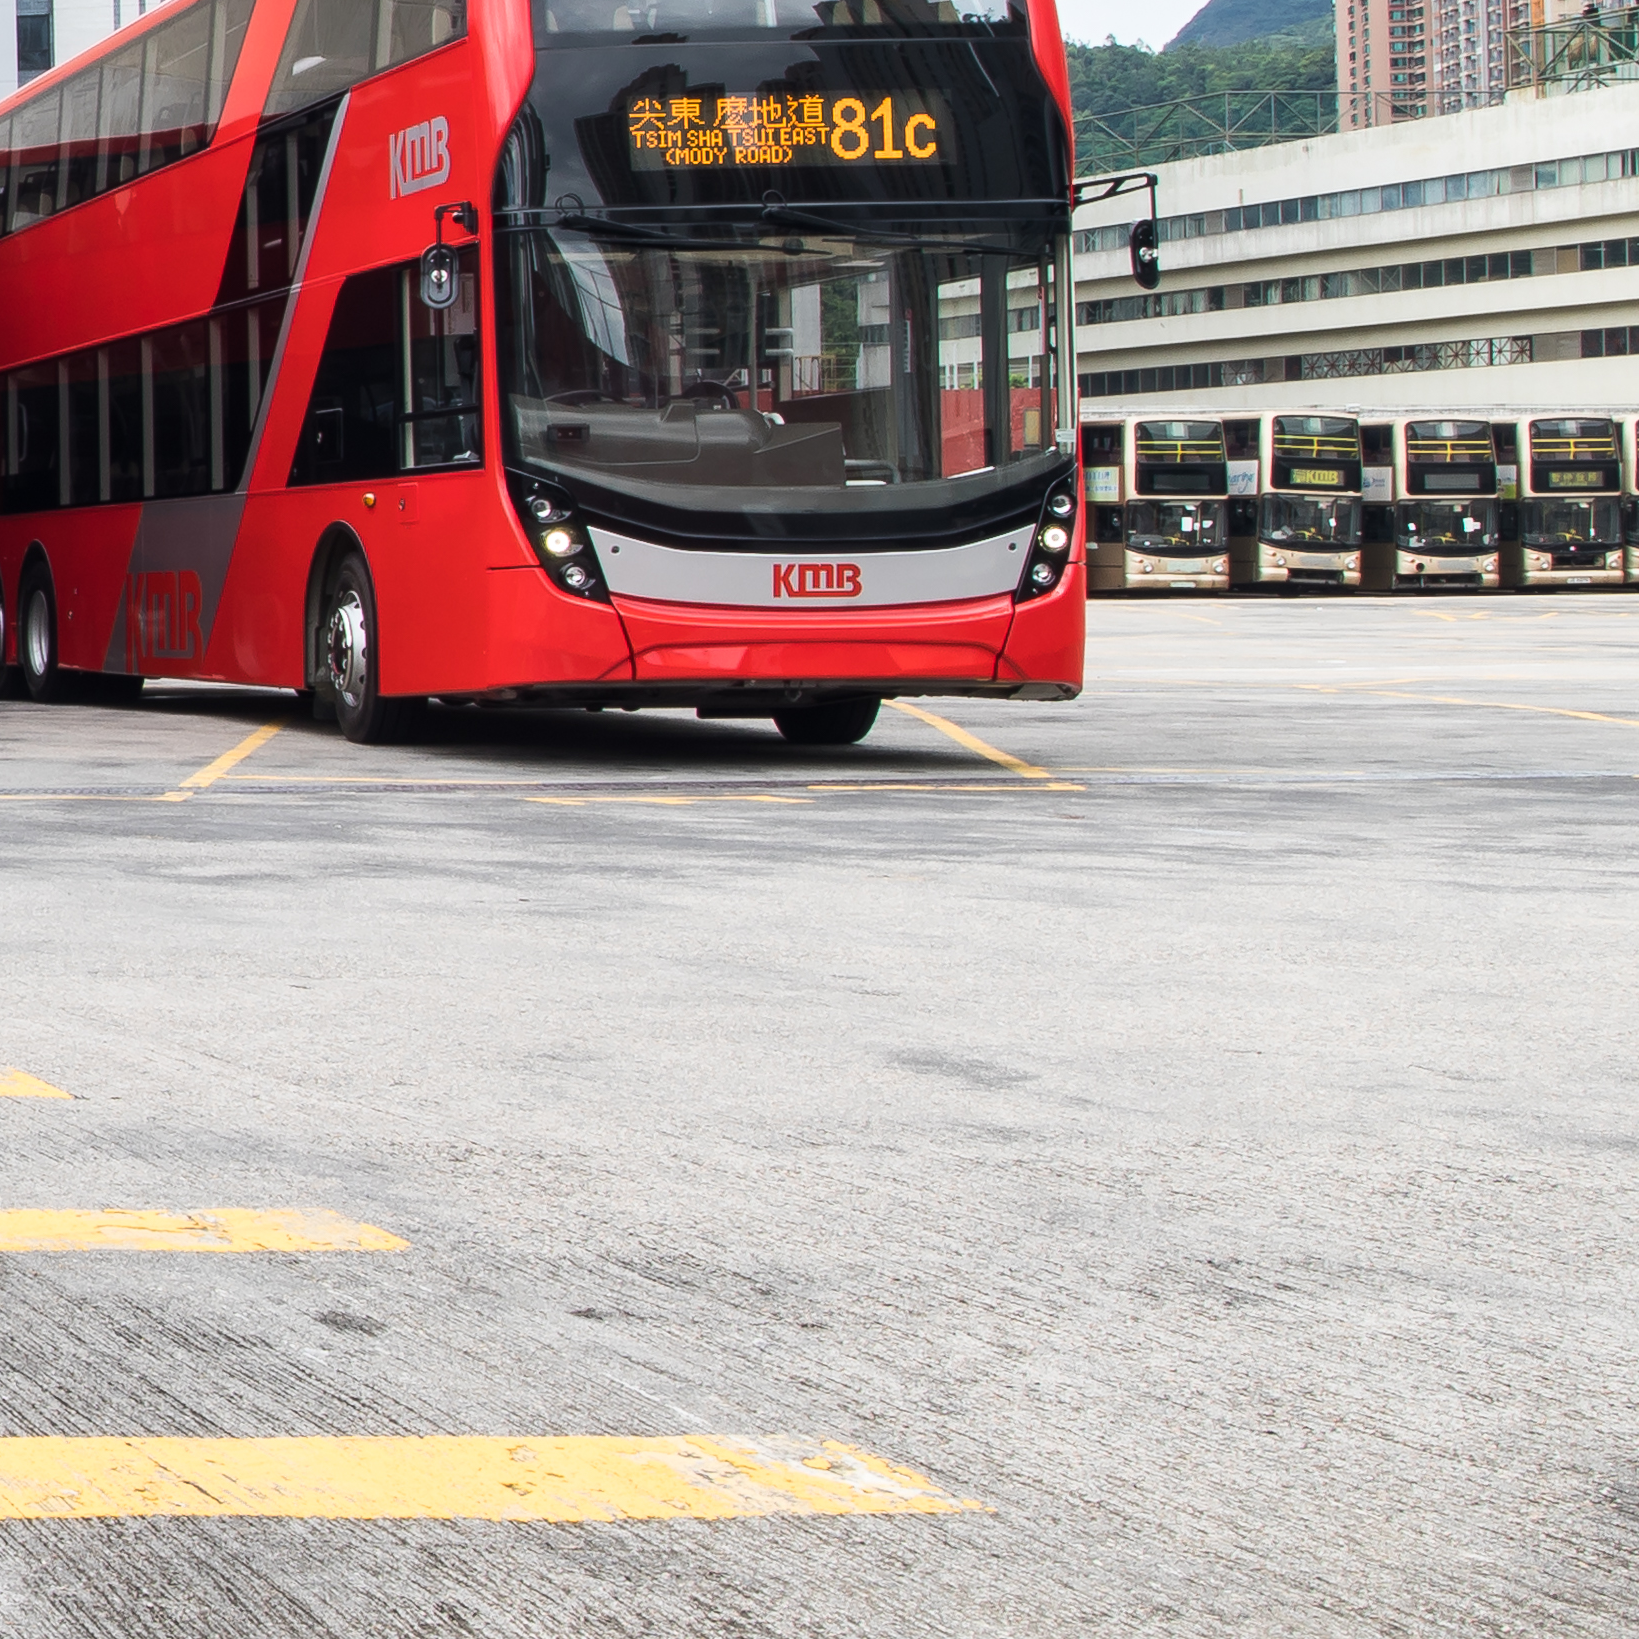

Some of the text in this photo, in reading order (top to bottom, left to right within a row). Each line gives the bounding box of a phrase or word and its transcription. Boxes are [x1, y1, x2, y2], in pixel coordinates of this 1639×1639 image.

[631, 127, 831, 149] TSIM SHA TSUI EAST
[389, 115, 451, 200] KMB
[665, 146, 793, 165] (MODY ROAD)
[773, 564, 862, 598] KMB
[126, 569, 202, 675] KMB
